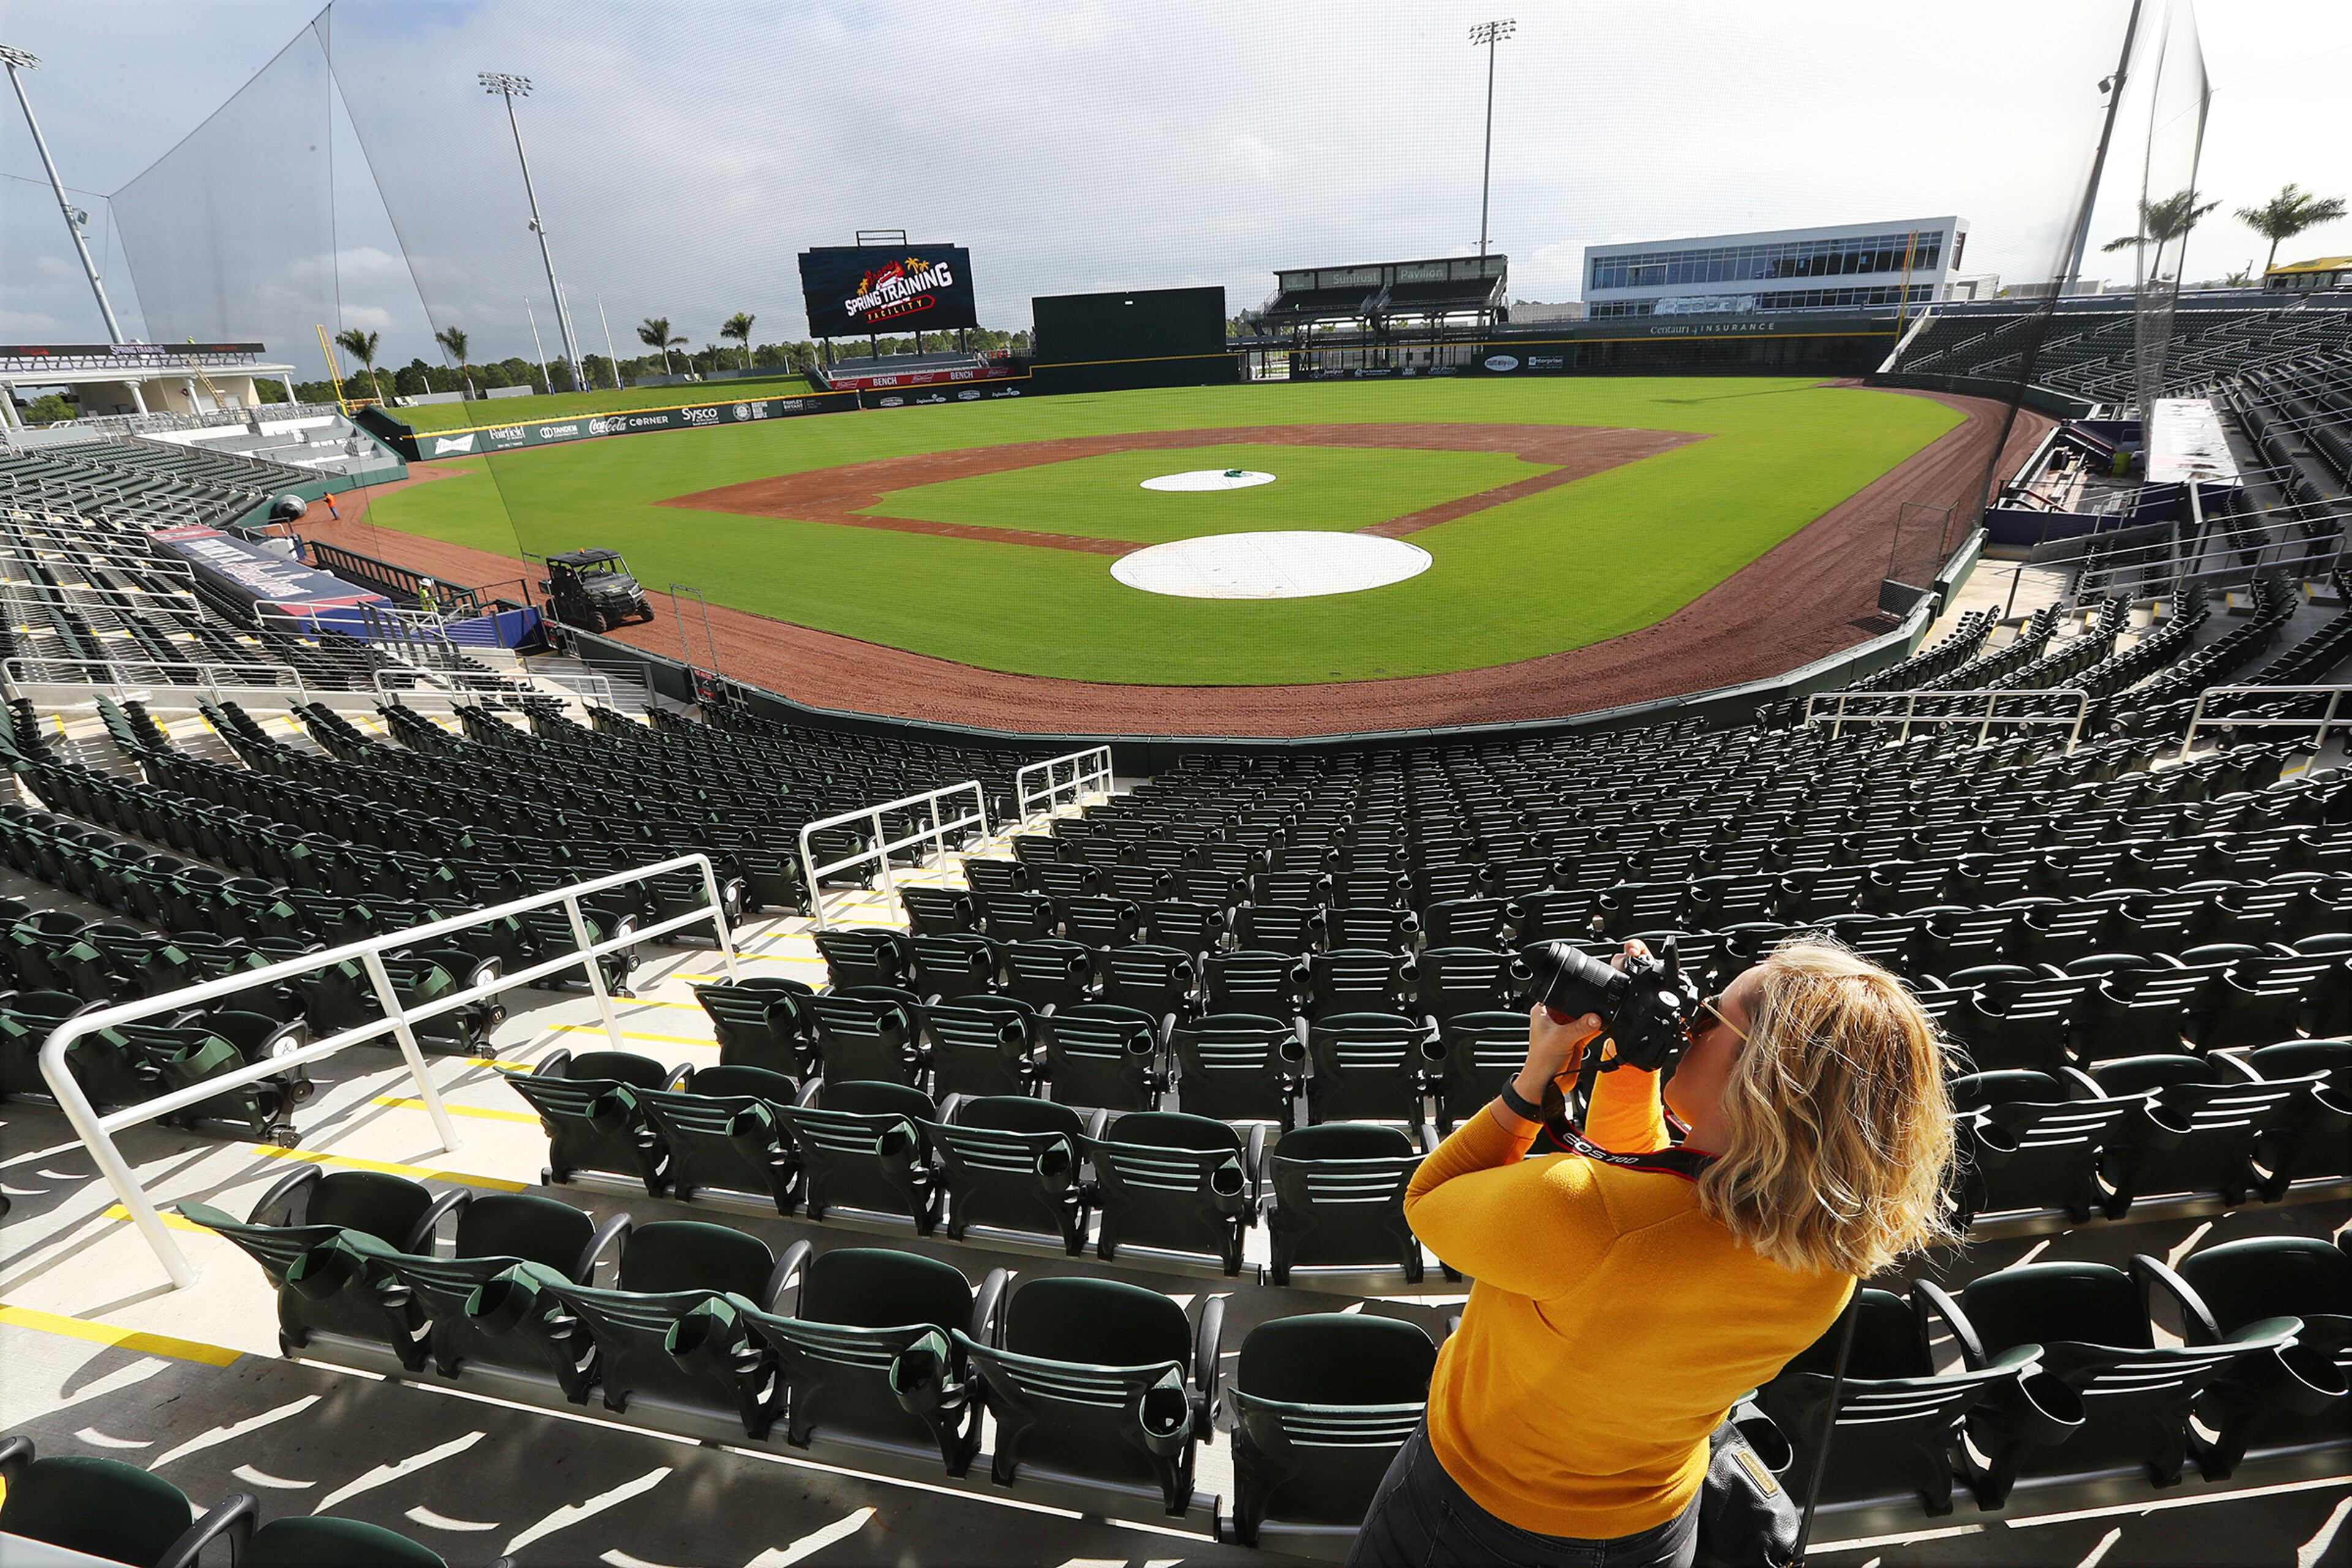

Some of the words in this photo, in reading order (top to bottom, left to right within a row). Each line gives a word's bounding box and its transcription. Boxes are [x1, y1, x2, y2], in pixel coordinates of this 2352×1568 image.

[1333, 273, 1378, 284] SunTrust
[1401, 270, 1443, 279] Pavilion
[845, 290, 880, 317] SPRING
[880, 262, 953, 303] TRAINING
[867, 300, 922, 320] FACILITY
[1650, 325, 1689, 334] Centauri
[1700, 323, 1774, 331] INSURANCE
[110, 345, 137, 355] SPRING
[136, 345, 165, 354] TRAINING
[872, 377, 897, 386] BENCH
[951, 371, 973, 380] BENCH
[629, 415, 669, 426] CORNER
[682, 408, 717, 421] Sysco
[489, 426, 526, 440] Fairfield
[553, 424, 578, 434] TANDEM
[1563, 1133, 1607, 1159] EOS
[1606, 1155, 1639, 1164] 70D
